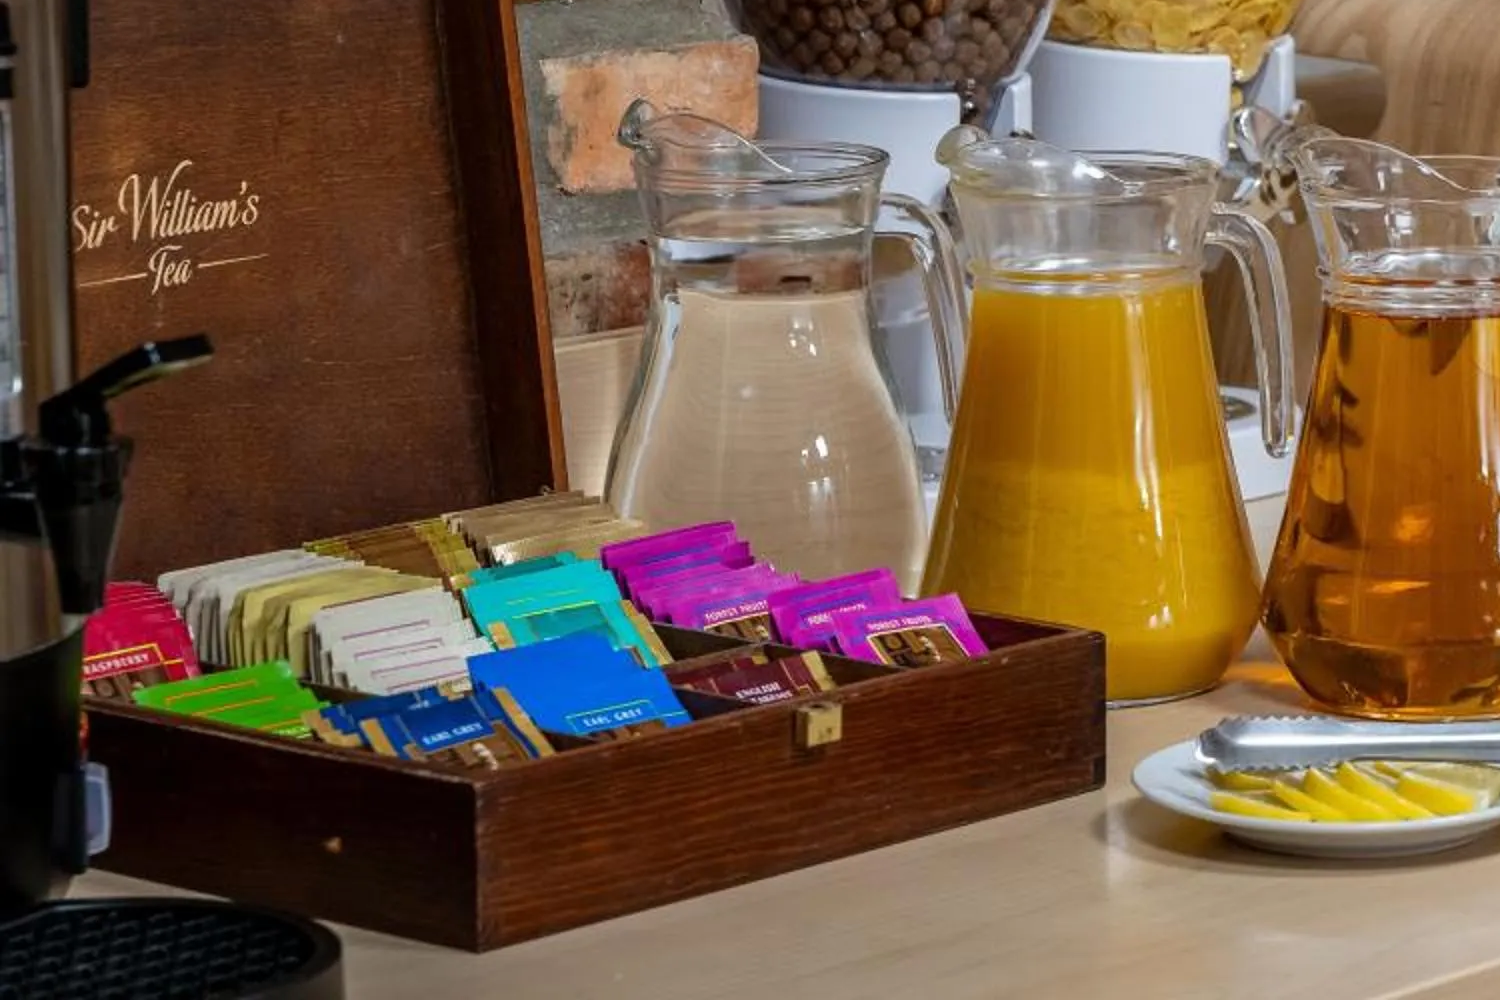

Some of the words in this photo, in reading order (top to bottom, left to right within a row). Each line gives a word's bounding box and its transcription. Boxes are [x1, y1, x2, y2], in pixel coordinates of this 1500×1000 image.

[72, 204, 119, 251] Sir
[118, 160, 260, 242] William's
[148, 245, 193, 296] Tea
